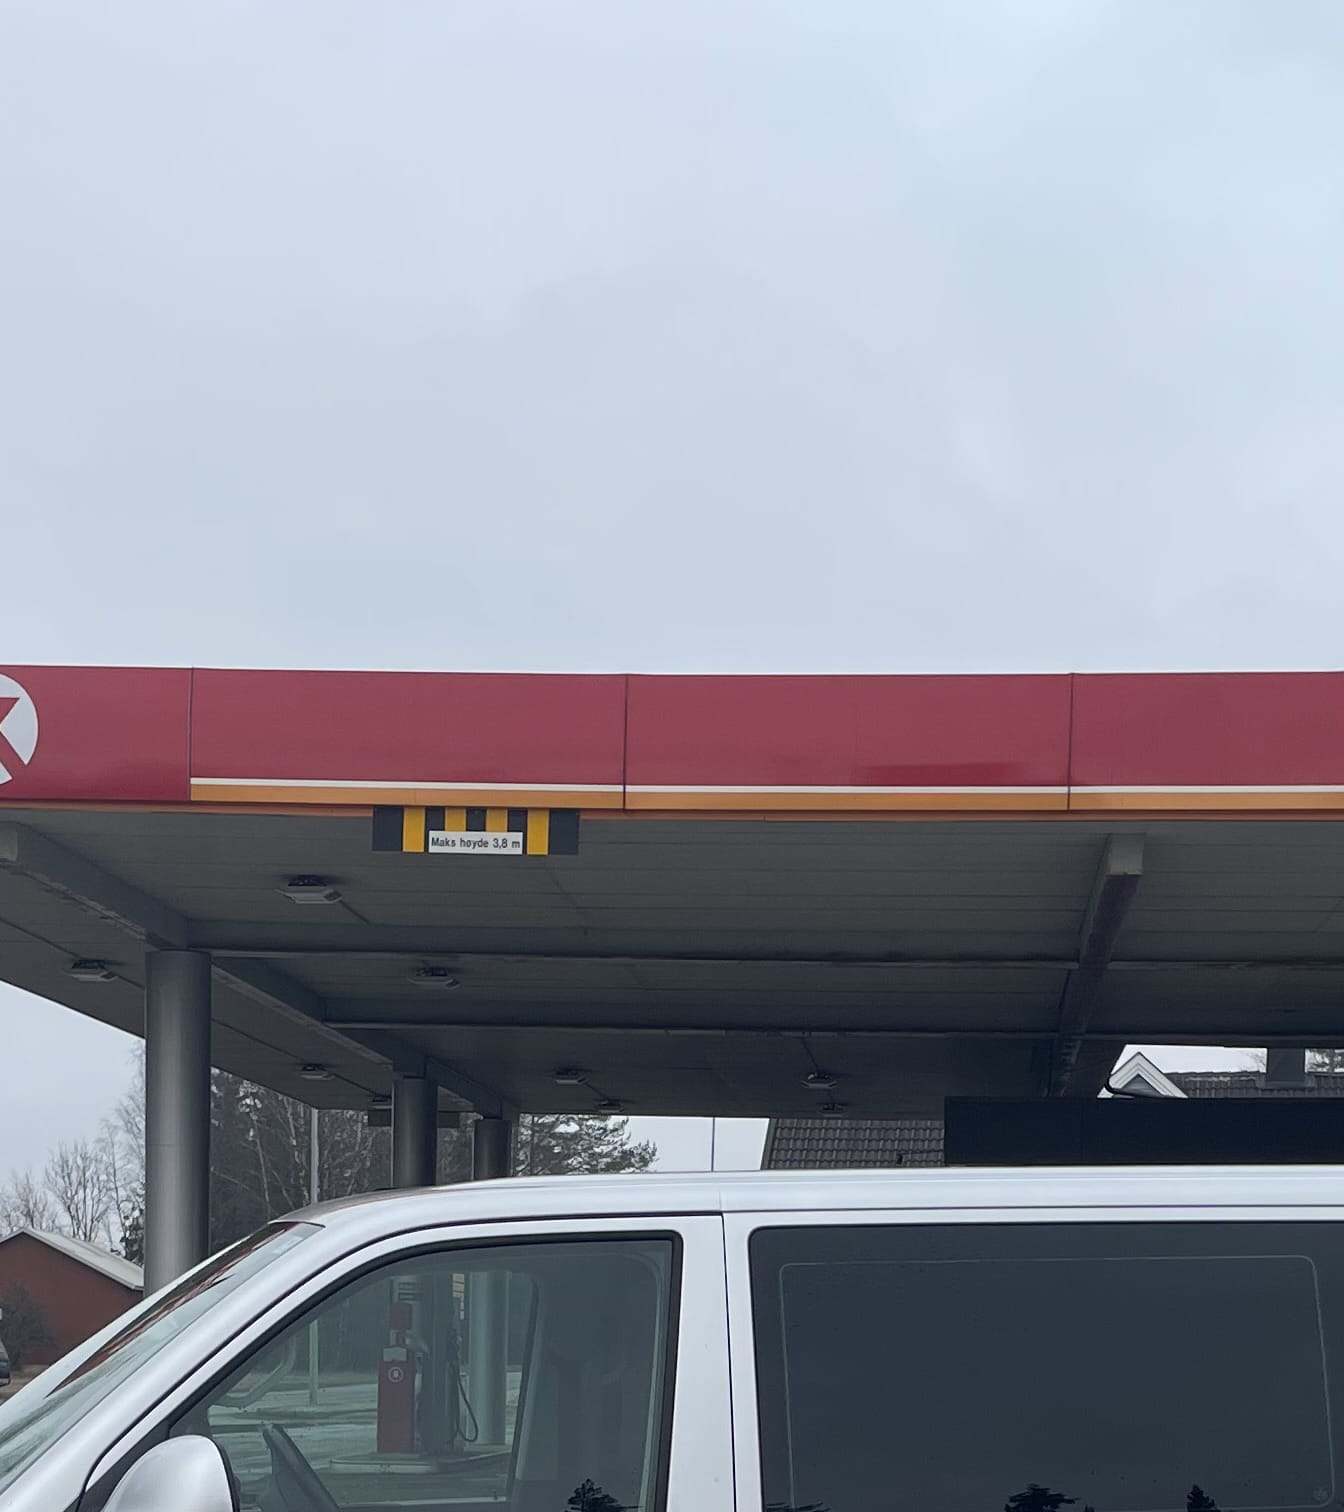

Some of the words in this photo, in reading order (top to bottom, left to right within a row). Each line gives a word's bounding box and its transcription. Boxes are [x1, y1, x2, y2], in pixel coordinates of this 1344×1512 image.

[431, 837, 456, 848] Maks
[459, 837, 489, 850] høyde
[492, 838, 508, 849] 3,8
[511, 841, 521, 849] m
